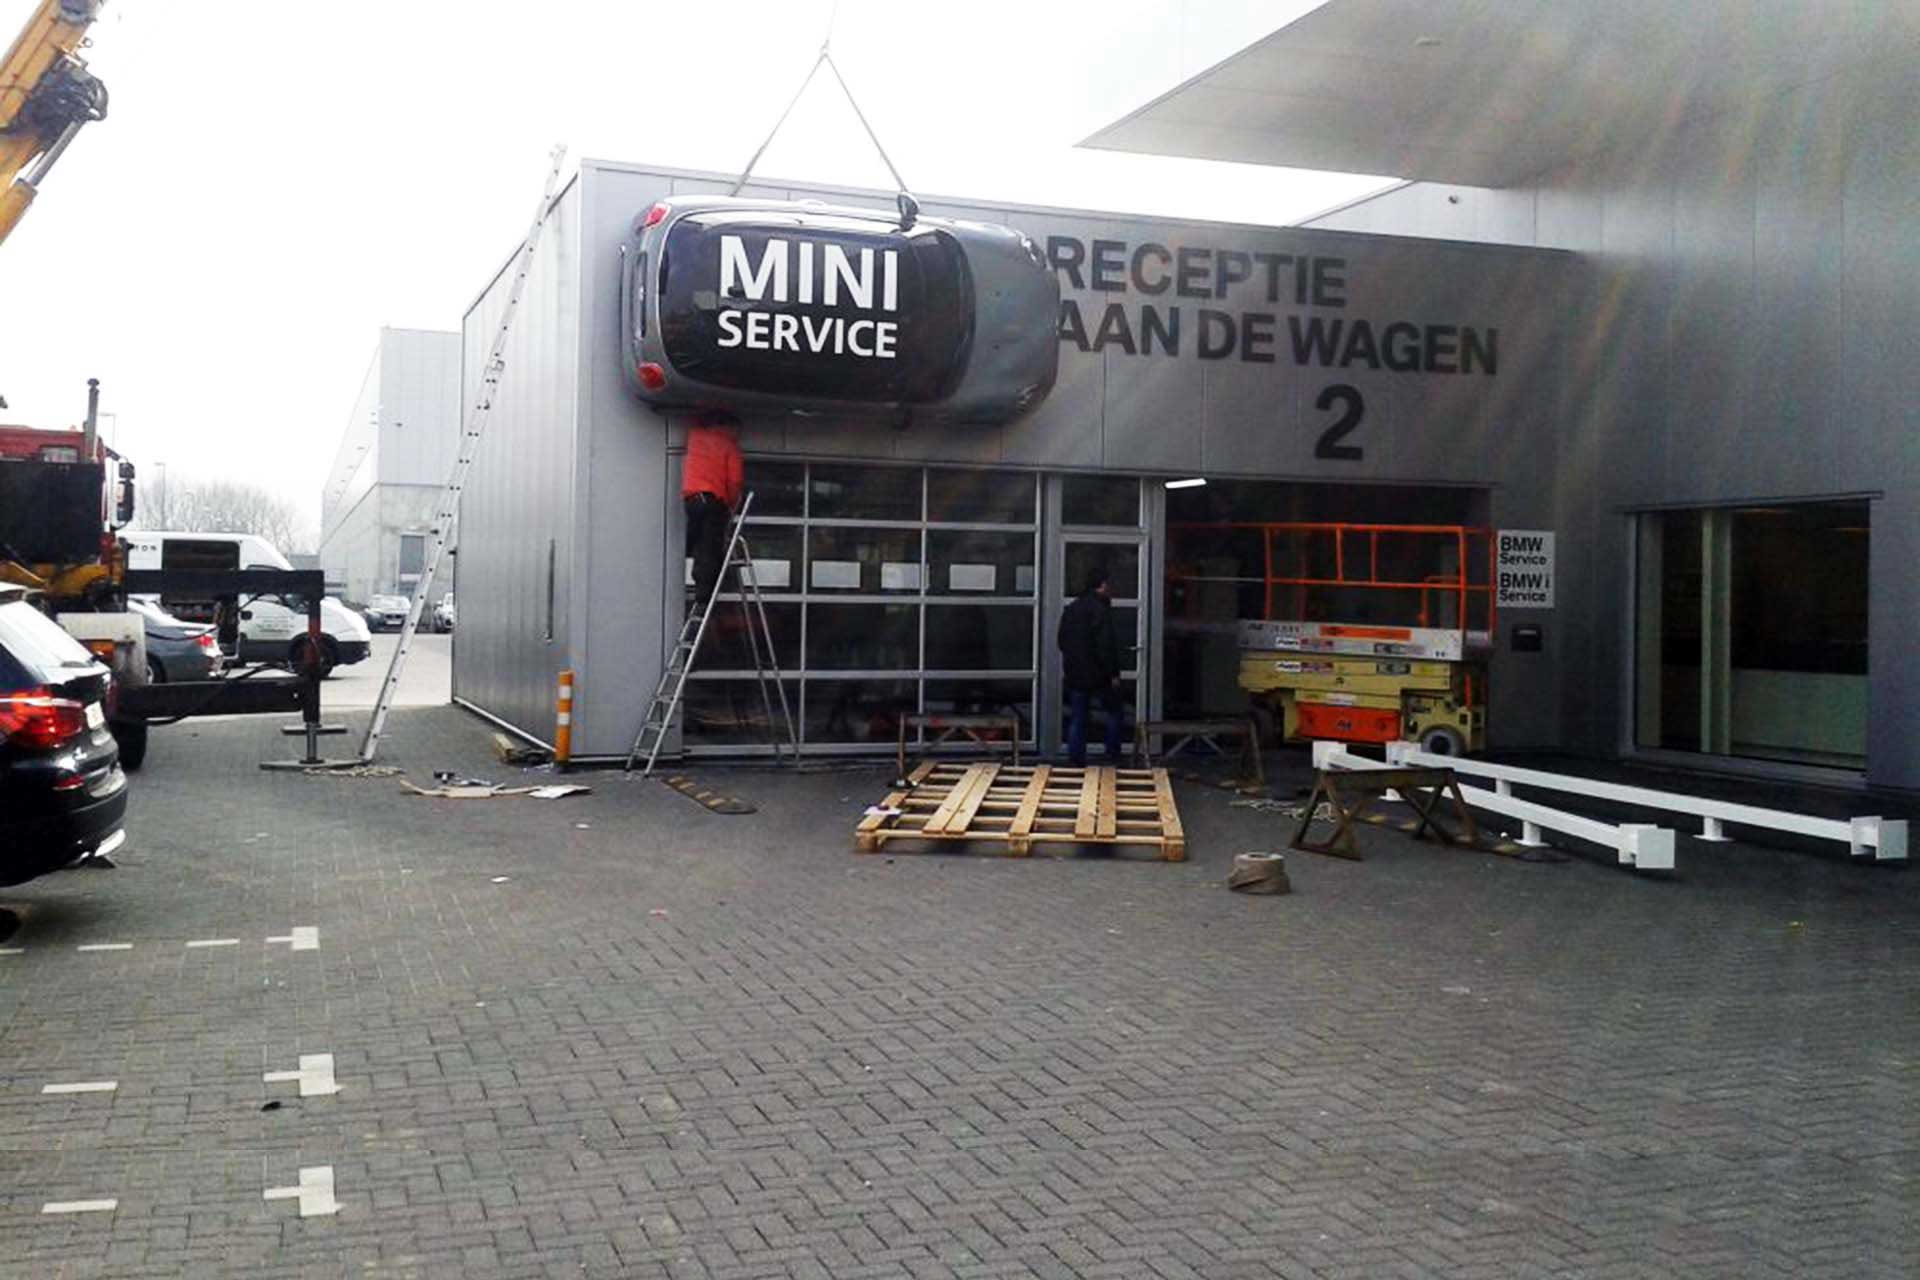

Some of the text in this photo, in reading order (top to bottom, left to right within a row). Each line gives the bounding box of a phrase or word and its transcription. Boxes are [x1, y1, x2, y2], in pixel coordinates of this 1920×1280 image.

[719, 235, 899, 312] MINI
[1047, 235, 1346, 308] RECEPTIE
[717, 310, 898, 358] SERVICE
[1056, 299, 1498, 375] AAN DE WAGEN
[1314, 383, 1365, 462] 2
[1500, 536, 1543, 551] BMW
[1500, 552, 1547, 565] Service
[1500, 573, 1542, 588] BMW
[1500, 589, 1546, 601] Service
